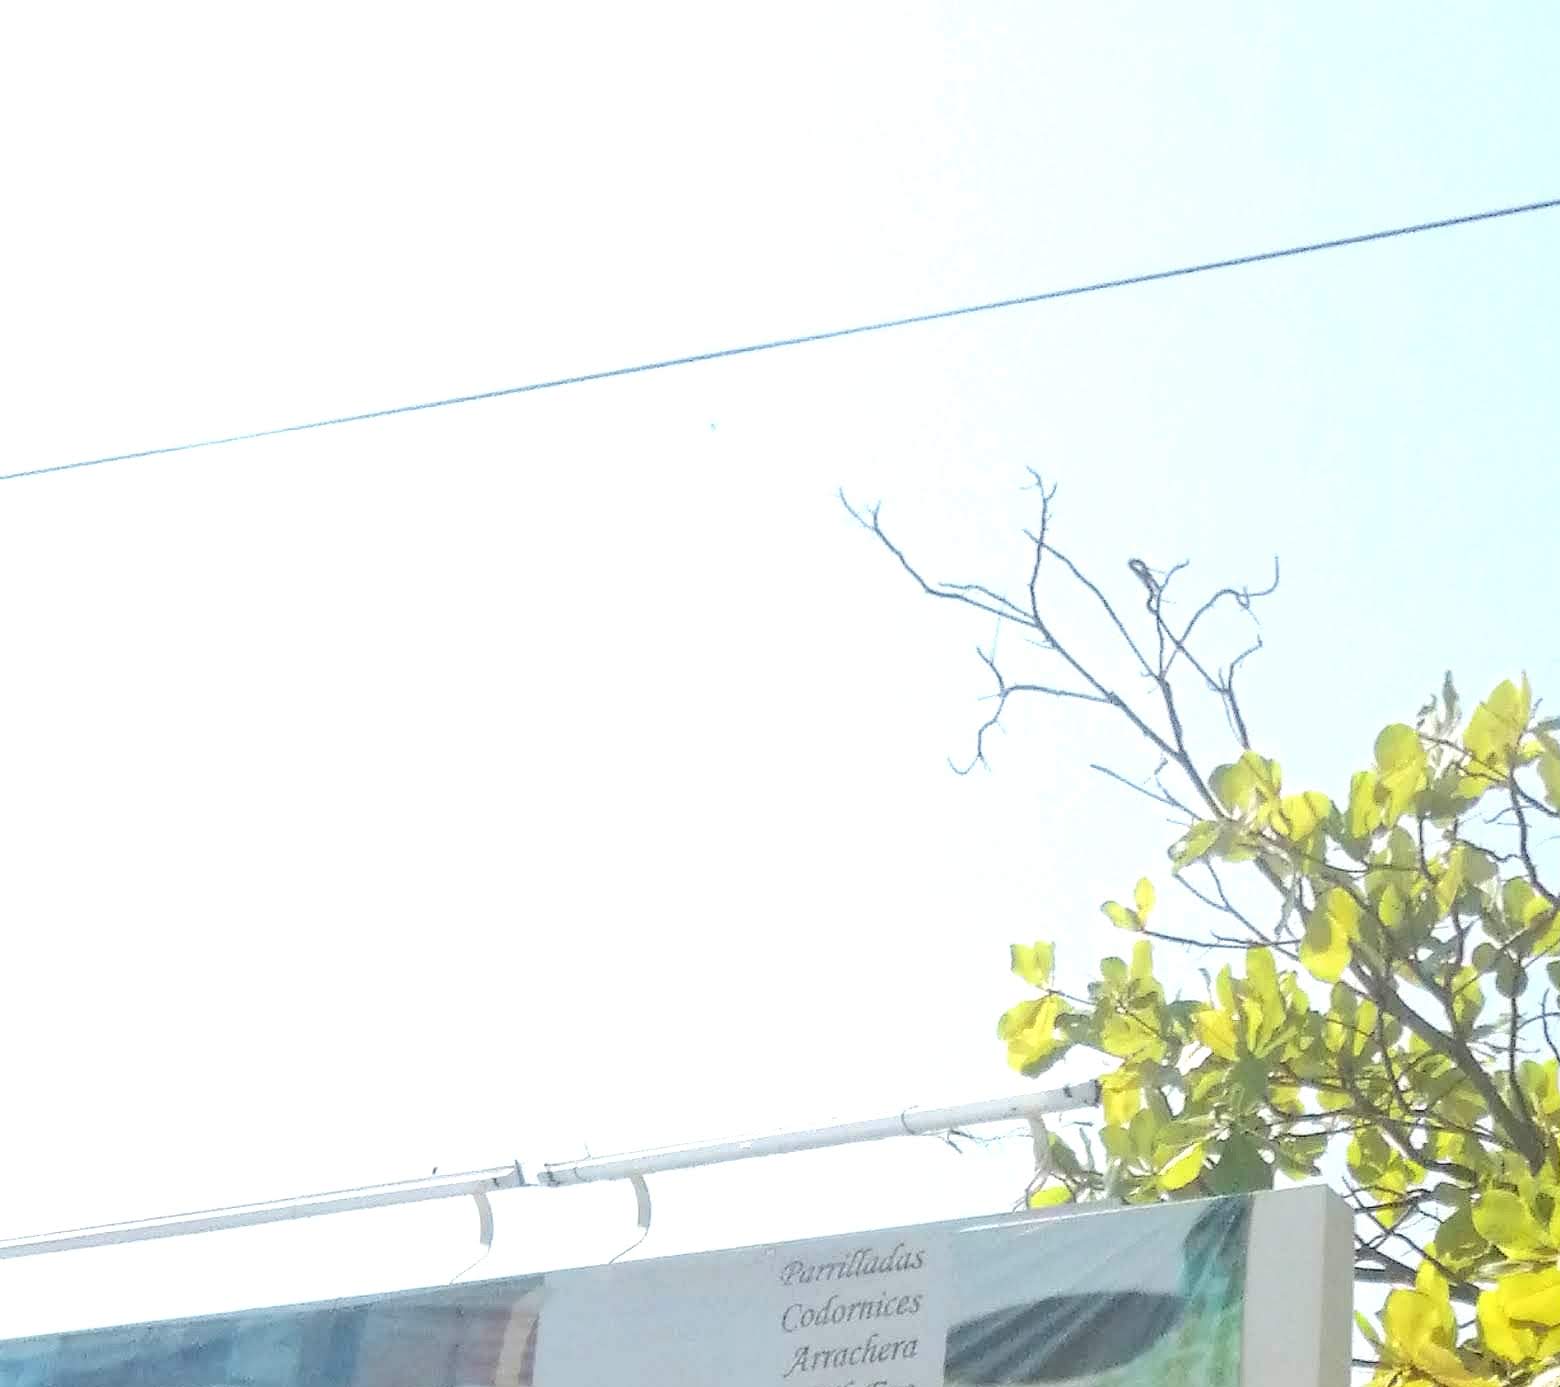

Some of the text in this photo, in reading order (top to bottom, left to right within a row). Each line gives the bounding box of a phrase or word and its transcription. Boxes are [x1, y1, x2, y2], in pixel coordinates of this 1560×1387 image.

[779, 1243, 926, 1286] Parrilladas
[781, 1290, 922, 1333] Codornices
[783, 1333, 919, 1378] Arrachera
